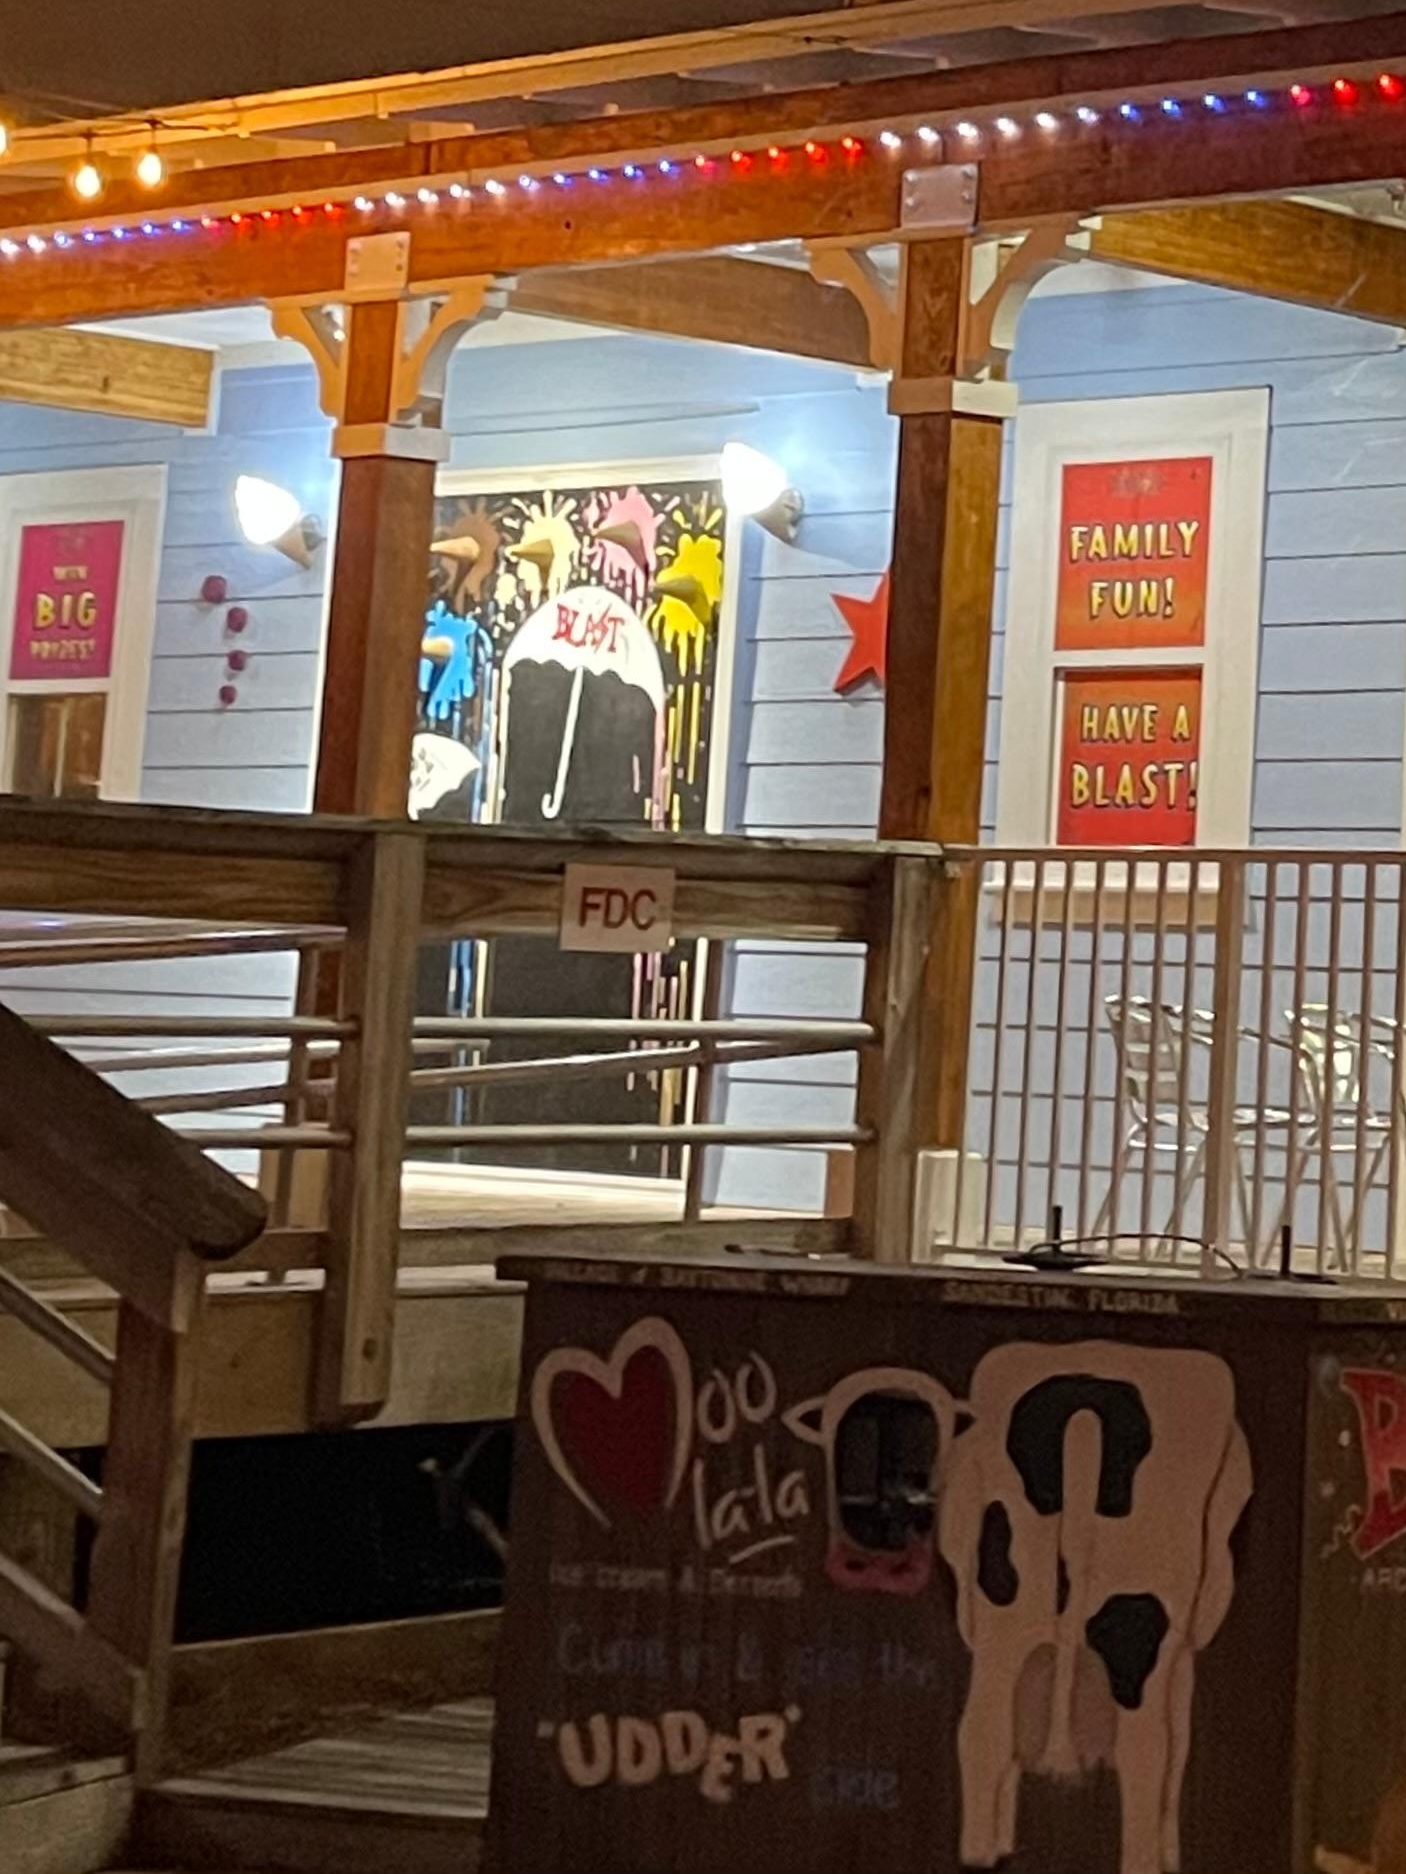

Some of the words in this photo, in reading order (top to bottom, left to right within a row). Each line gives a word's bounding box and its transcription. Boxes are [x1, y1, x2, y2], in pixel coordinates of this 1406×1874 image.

[1069, 520, 1199, 563] FAMILY
[34, 591, 97, 629] BIG
[1089, 577, 1175, 620] FUN!
[552, 603, 625, 653] BLAST
[1080, 704, 1159, 743] HAVE
[1170, 703, 1191, 741] A
[1069, 761, 1198, 810] BLAST!
[579, 886, 656, 931] FDC
[1087, 1287, 1180, 1314] FLORIDA
